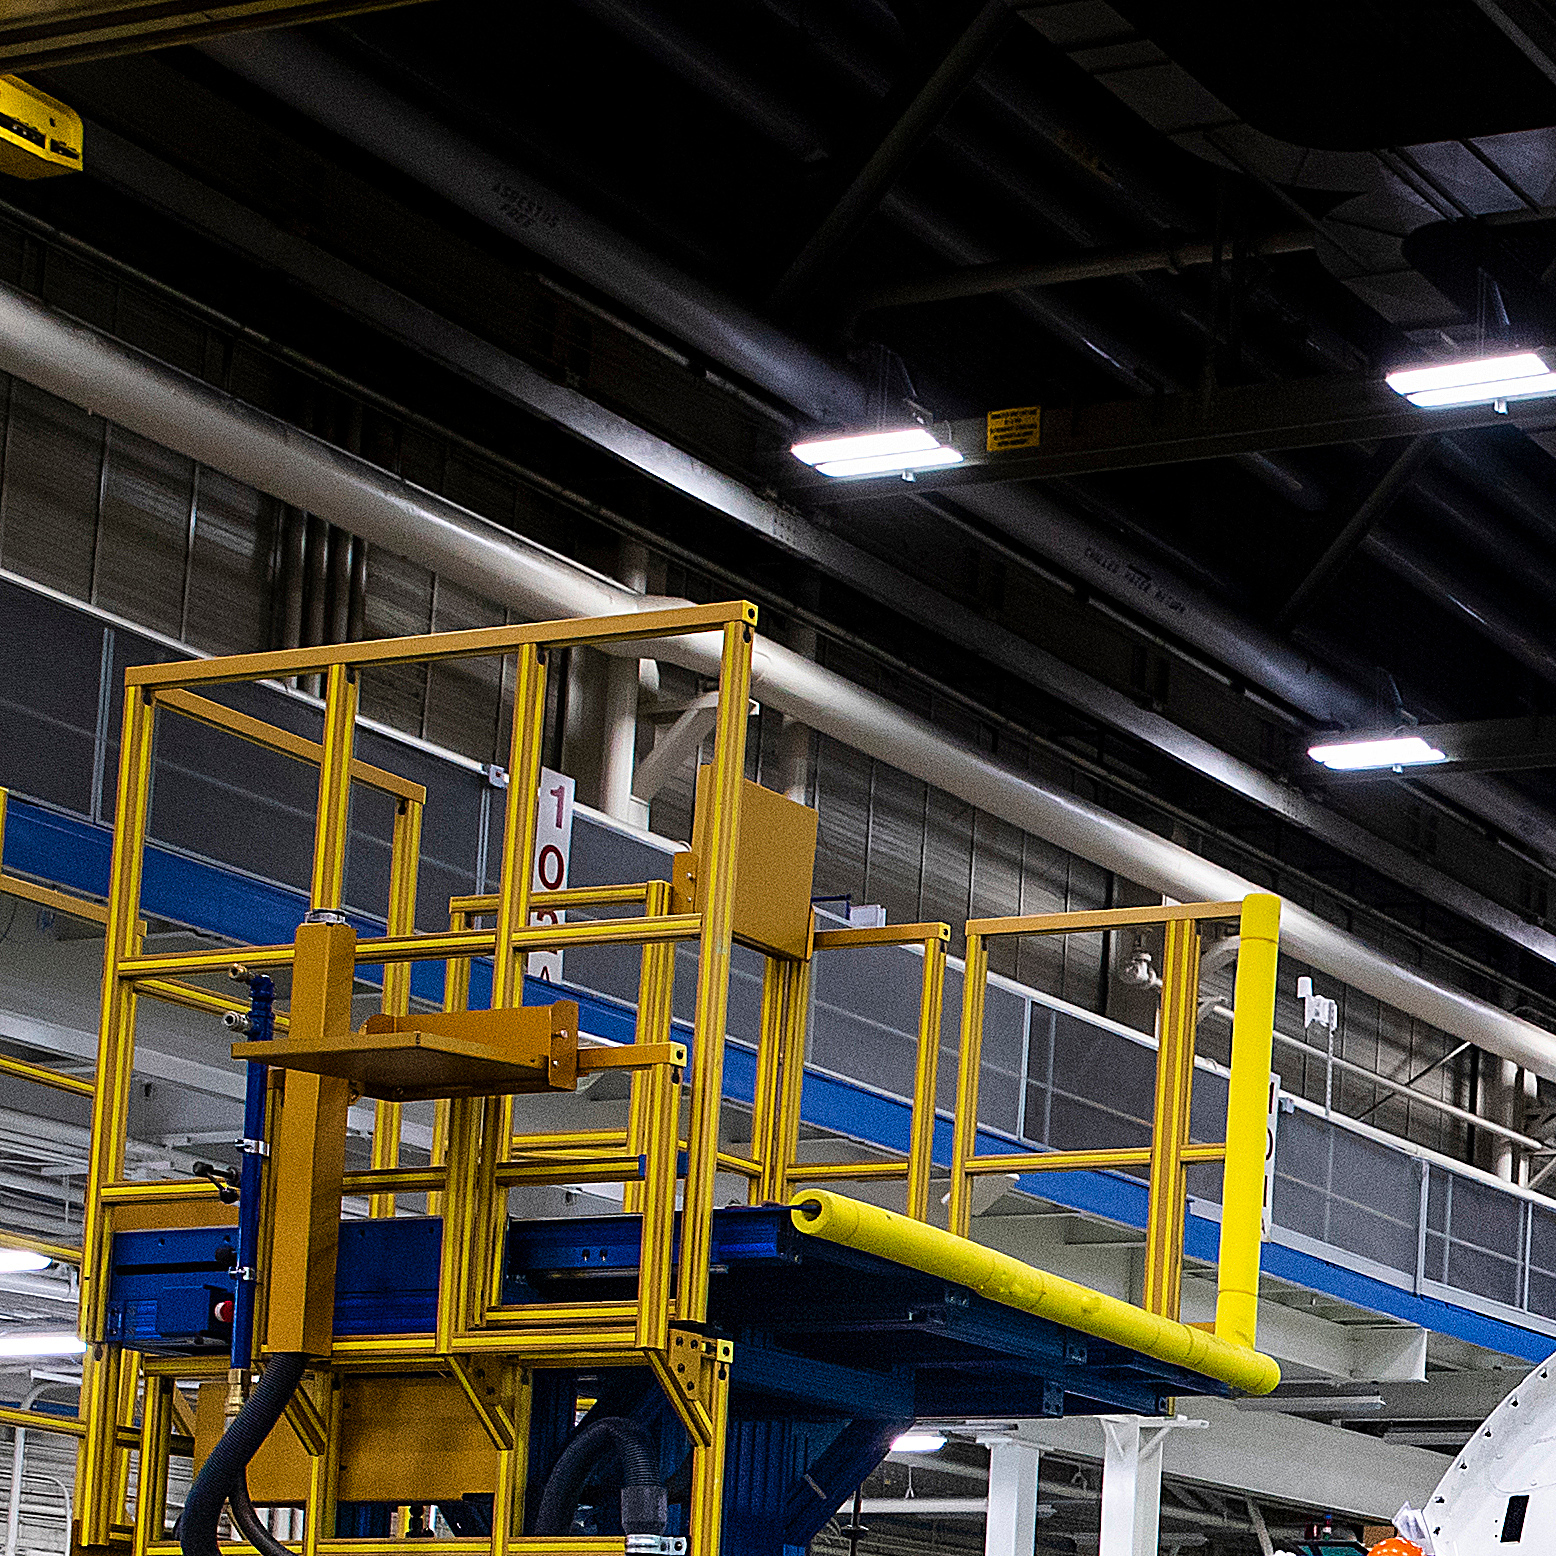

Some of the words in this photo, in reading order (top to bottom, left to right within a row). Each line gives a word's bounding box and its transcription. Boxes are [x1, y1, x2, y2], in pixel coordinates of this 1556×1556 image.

[492, 182, 559, 228] ASBESTOS
[499, 203, 535, 228] FREE
[1124, 571, 1152, 593] WATER
